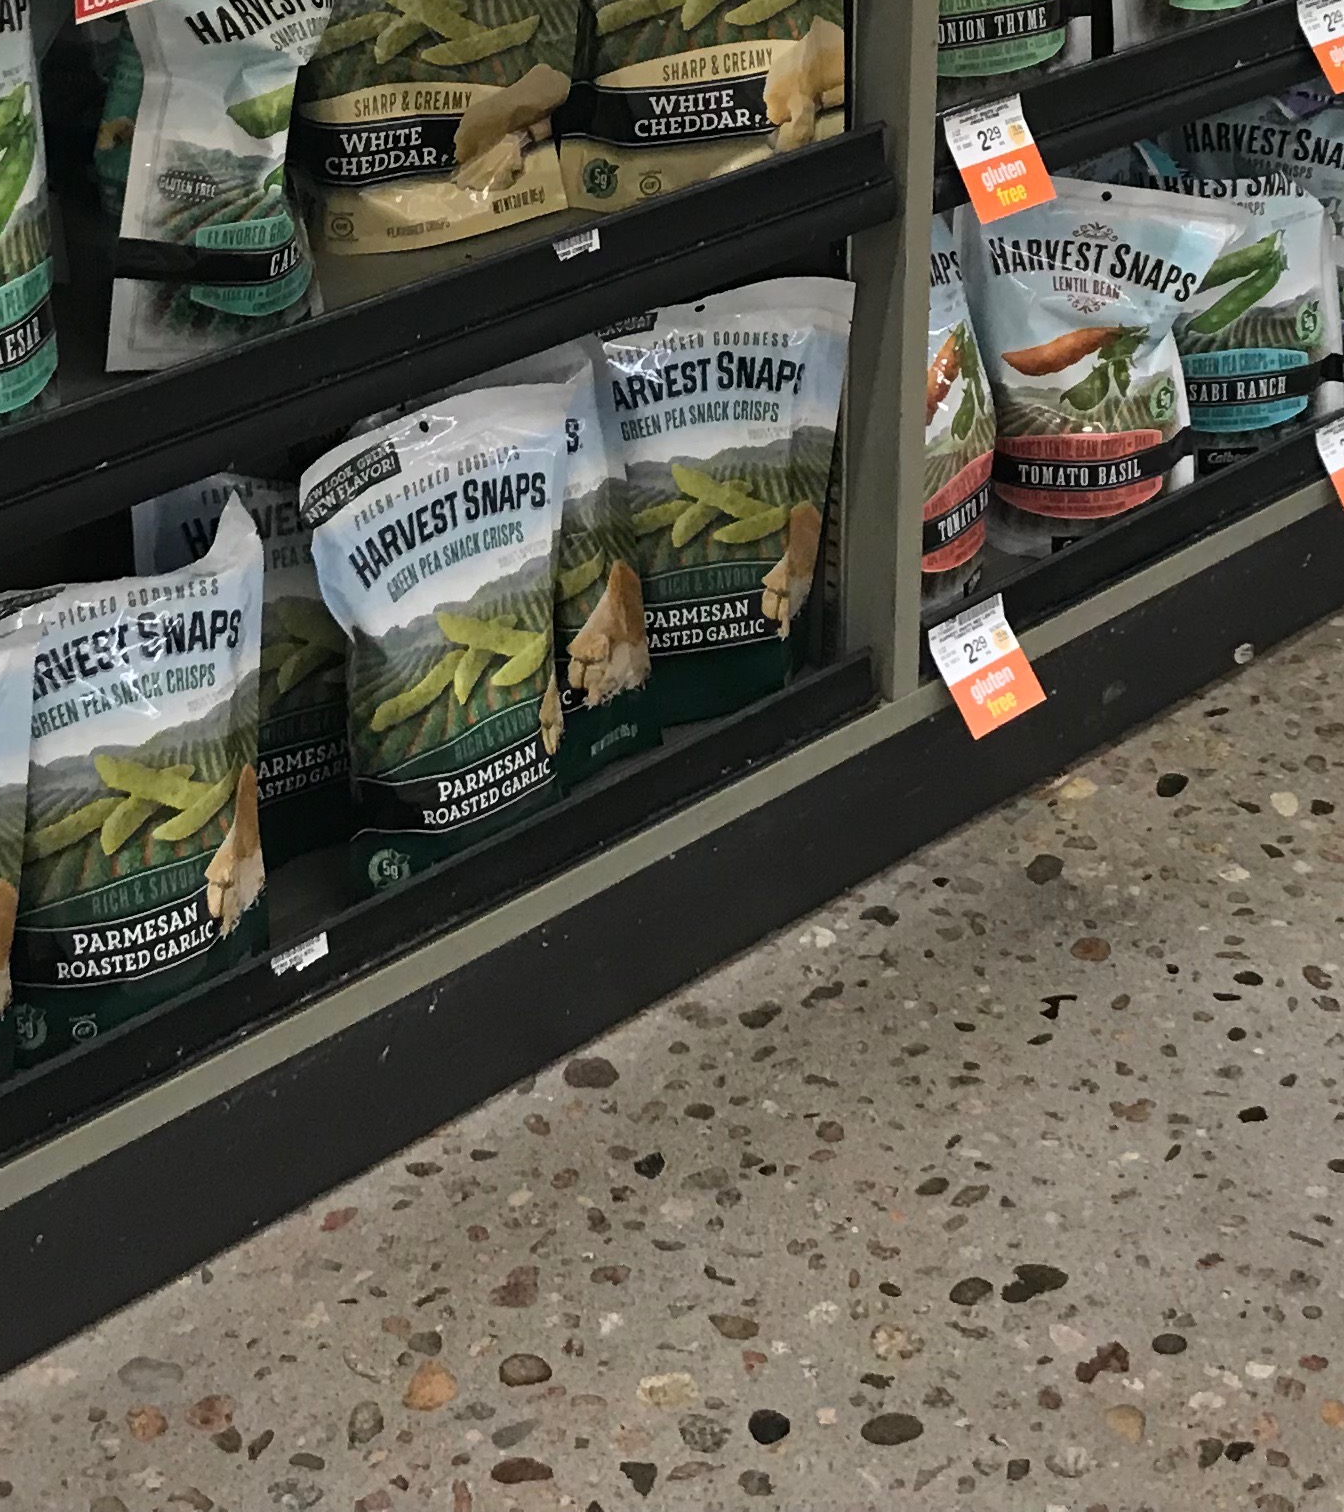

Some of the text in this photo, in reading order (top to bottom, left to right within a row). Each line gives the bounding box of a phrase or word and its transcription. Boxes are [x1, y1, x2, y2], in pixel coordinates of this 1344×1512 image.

[994, 6, 1047, 36] THYME
[662, 47, 774, 82] SHARP CREAMY
[354, 90, 473, 117] SHARP CREAMY
[649, 89, 735, 115] WHITE
[340, 126, 423, 155] WHITE
[634, 110, 751, 139] CHEDDAR
[1182, 121, 1291, 159] HARVEST
[324, 150, 438, 178] CHEDDAR
[981, 159, 1027, 193] gluten
[989, 236, 1198, 303] HARVEST SNAPS
[716, 348, 806, 395] SNAPS
[1189, 375, 1287, 402] SABI RANCH
[620, 399, 780, 442] GREEN PEA SNACK CRISPS
[338, 456, 397, 506] FLAVOR!
[1018, 458, 1142, 486] TOMATO BASIL
[348, 471, 548, 590] HARVEST SNAPS
[937, 505, 978, 543] TOMATO
[443, 520, 525, 568] SNACK CRISPS
[644, 598, 749, 630] PARMESAN
[706, 618, 765, 643] GARLIC
[31, 662, 216, 738] GREEN CRISPS
[970, 666, 1016, 705] gluten
[436, 740, 539, 804] PARMESAN
[422, 756, 553, 827] ROASTED GARLIC
[73, 901, 200, 956] PARMESAN
[56, 922, 215, 982] ROASTED GARLIC
